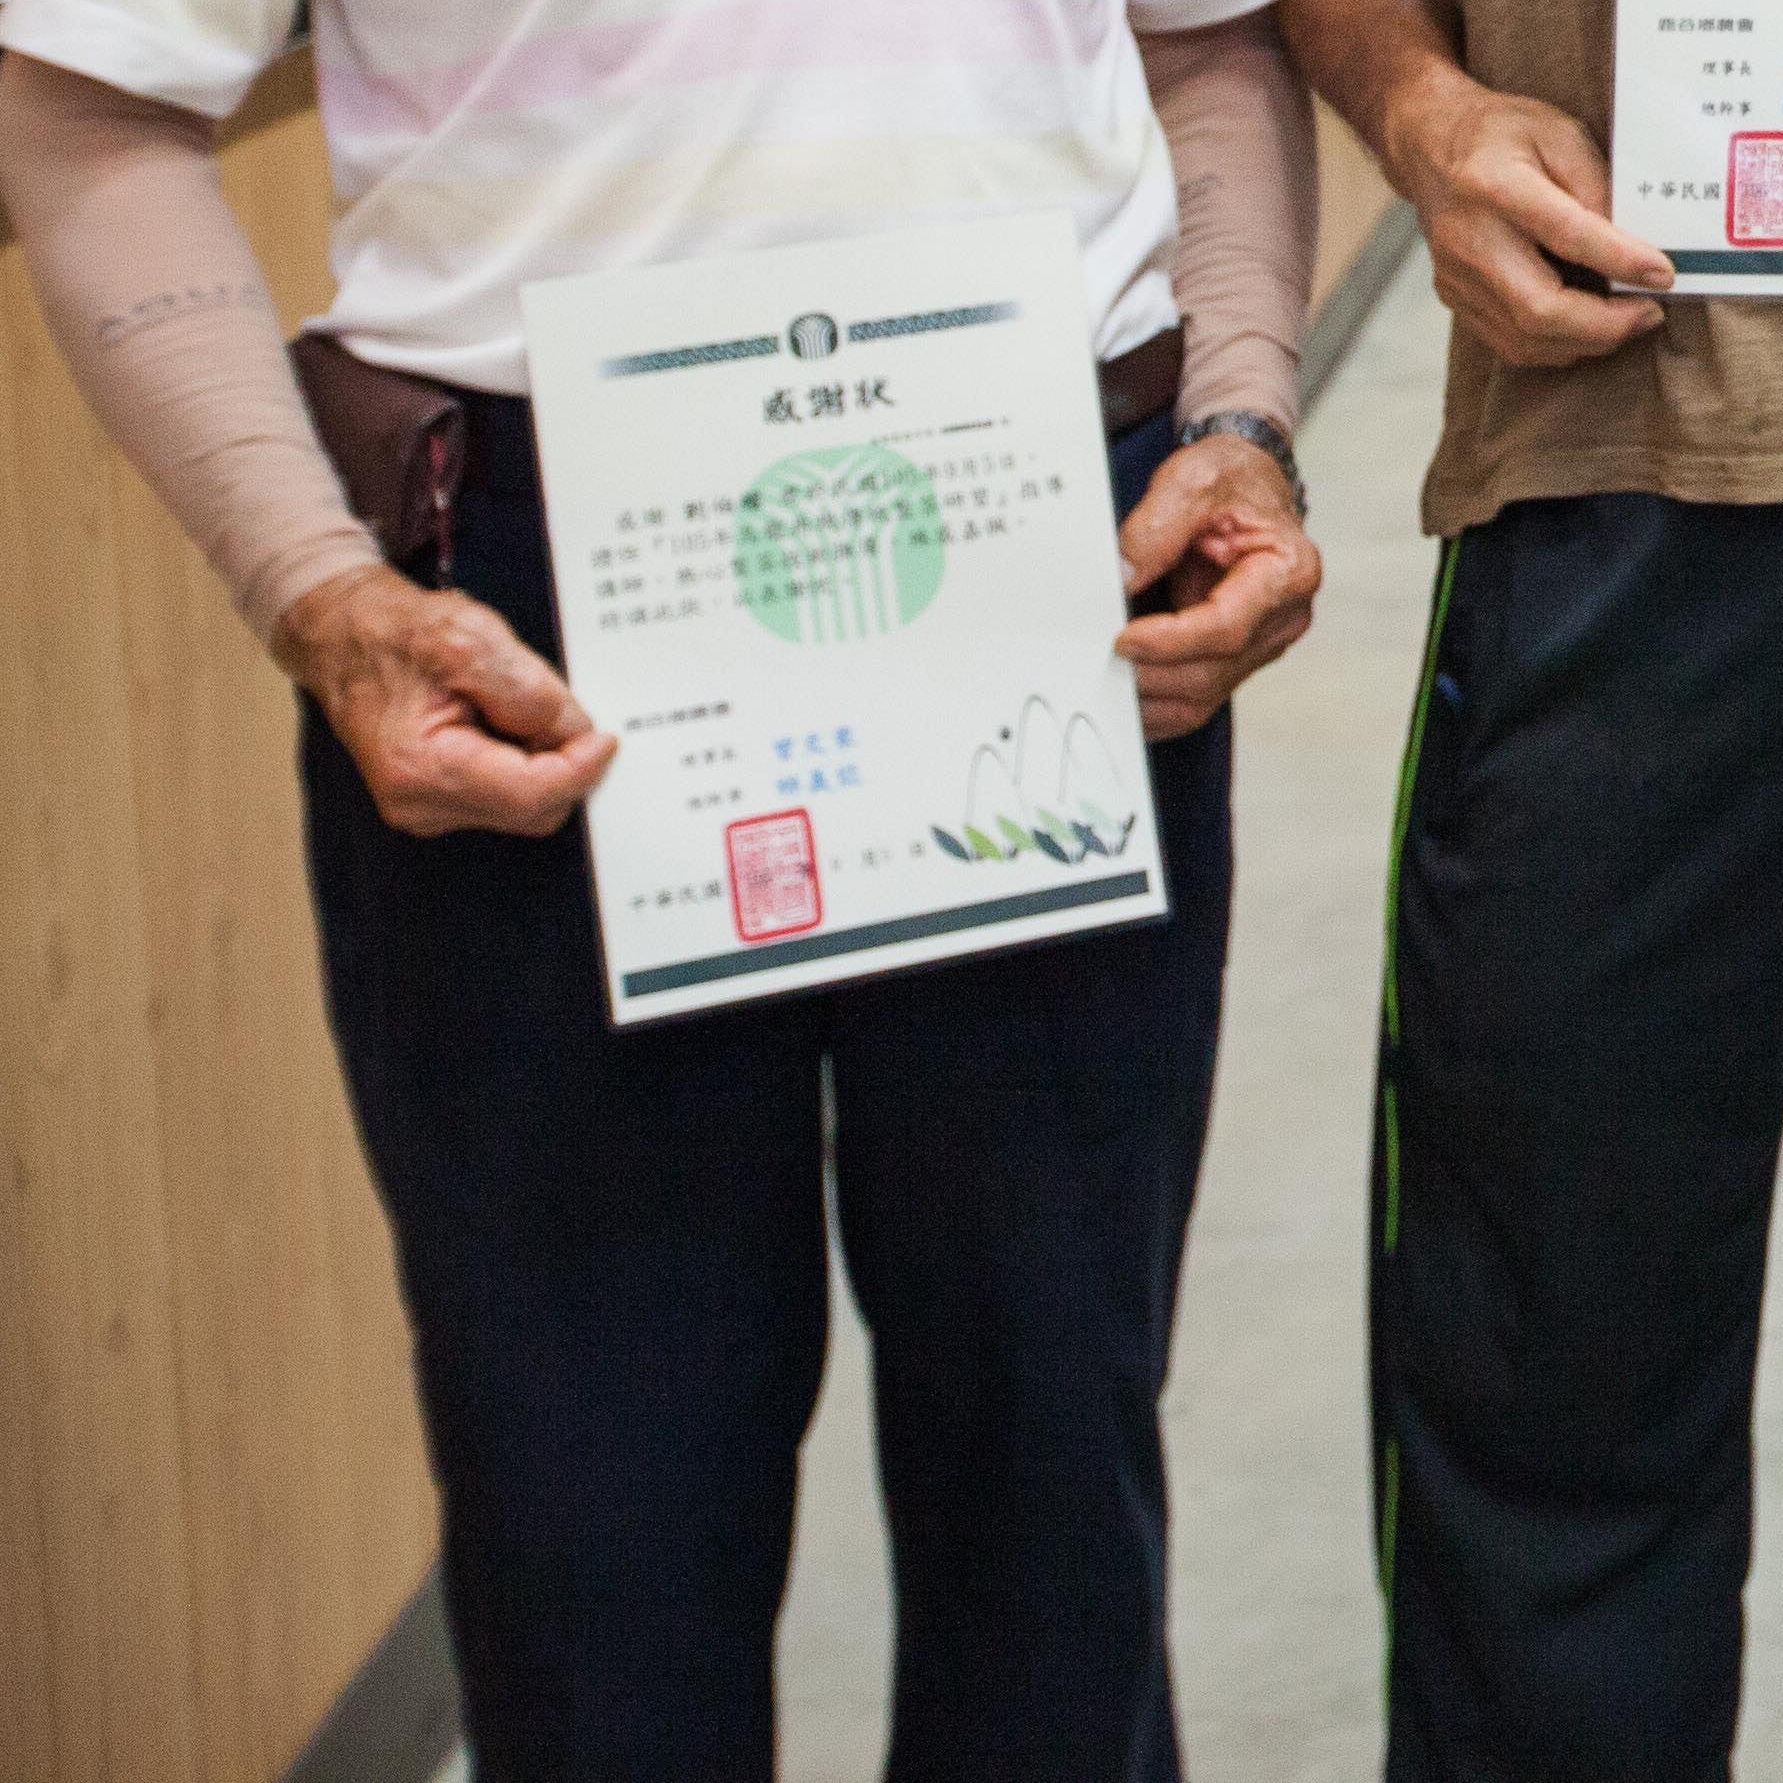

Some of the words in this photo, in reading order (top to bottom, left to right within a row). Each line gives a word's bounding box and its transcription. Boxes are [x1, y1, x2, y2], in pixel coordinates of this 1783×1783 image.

[1637, 181, 1721, 201] 中華民國
[763, 377, 897, 426] 感謝狀
